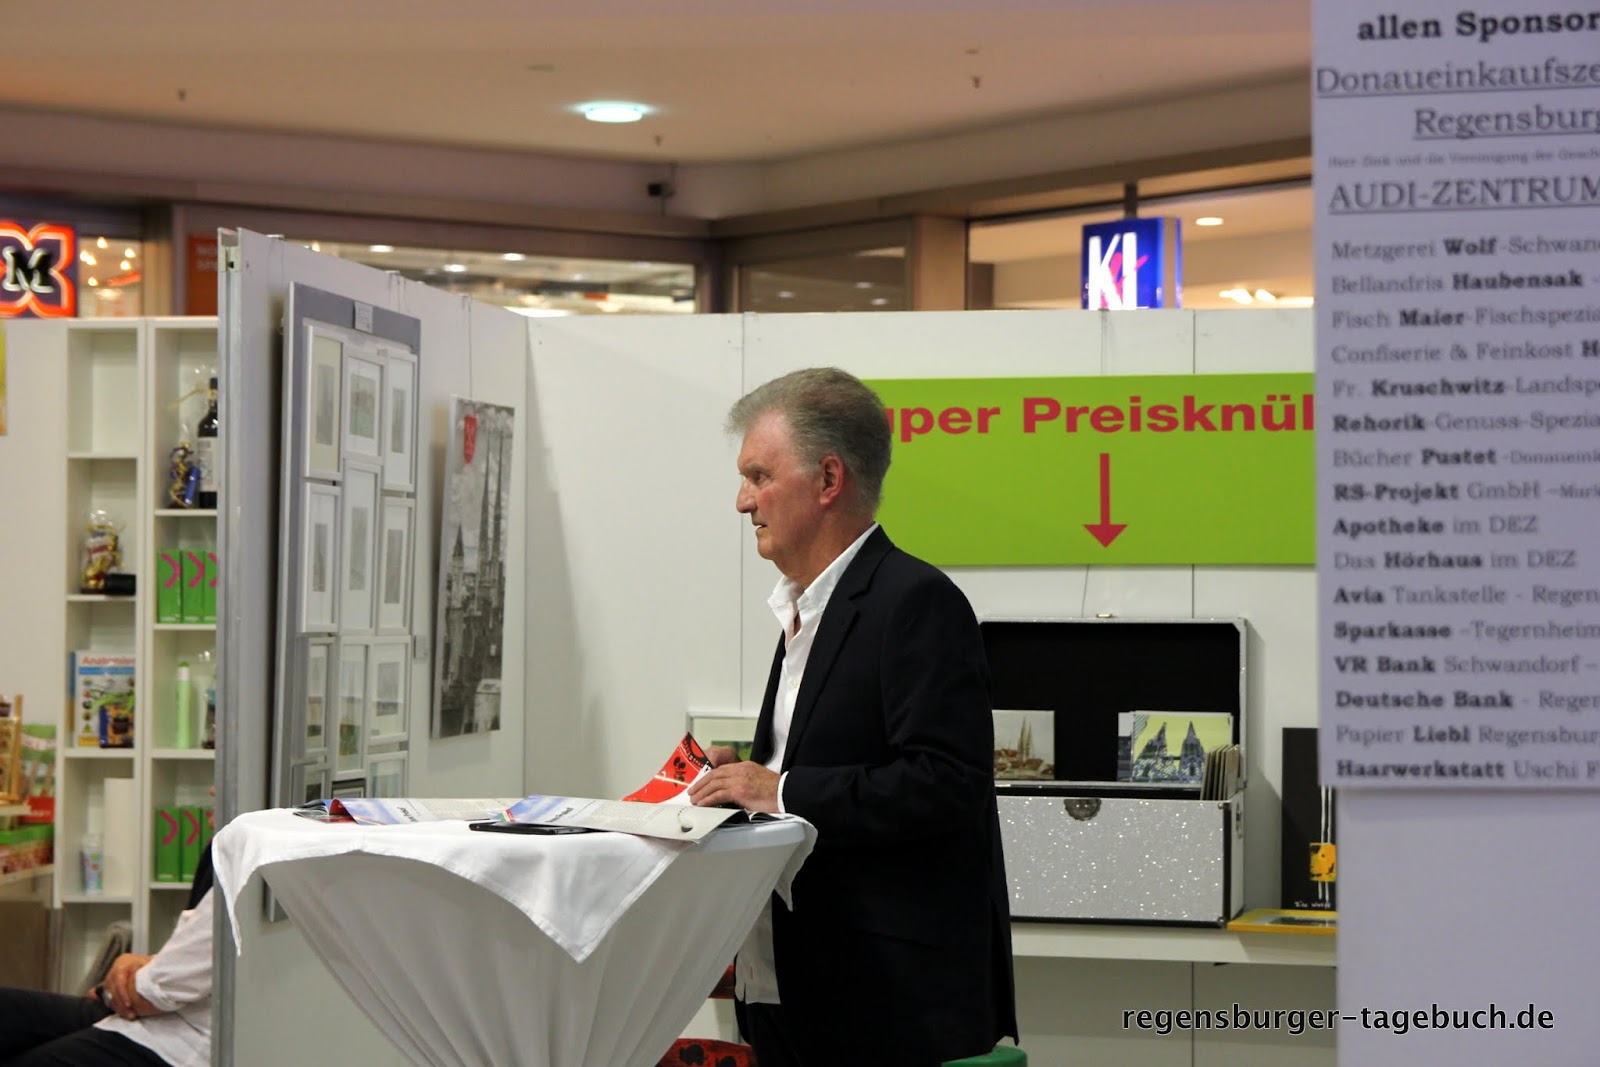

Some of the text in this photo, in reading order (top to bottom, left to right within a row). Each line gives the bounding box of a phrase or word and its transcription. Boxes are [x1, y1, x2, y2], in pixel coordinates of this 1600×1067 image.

[1357, 11, 1600, 43] allen Sponsor
[1332, 241, 1436, 262] Metzgerei
[1443, 238, 1496, 256] Wolf
[3, 245, 54, 294] M
[1332, 274, 1443, 295] Bellandris
[1453, 269, 1583, 291] Haubensak
[1332, 309, 1390, 329] Fisch
[1331, 340, 1600, 363] Confiserie & Feinkost H
[1332, 380, 1363, 398] Fr.
[886, 406, 1000, 442] per
[1332, 449, 1412, 469] Bücher
[1421, 449, 1497, 466] Pustet
[1333, 482, 1459, 506] RS-Projekt
[1466, 480, 1541, 499] GmbH
[1333, 515, 1538, 539] Apotheke im DEZ
[1334, 550, 1577, 569] Das Hörhaus im DEZ
[1333, 586, 1384, 604] Avia
[1391, 584, 1507, 604] Tankstelle
[1334, 621, 1451, 642] Sparkasse
[1334, 656, 1368, 673] VR
[1377, 655, 1436, 674] Bank
[1442, 653, 1581, 674] Schwandorf
[1335, 689, 1444, 708] Deutsche
[1454, 689, 1513, 708] Bank
[1336, 724, 1404, 746] Papier
[1413, 724, 1470, 743] Liebl
[1336, 758, 1504, 779] Haarwerkstatt
[1513, 758, 1579, 779] Uschi
